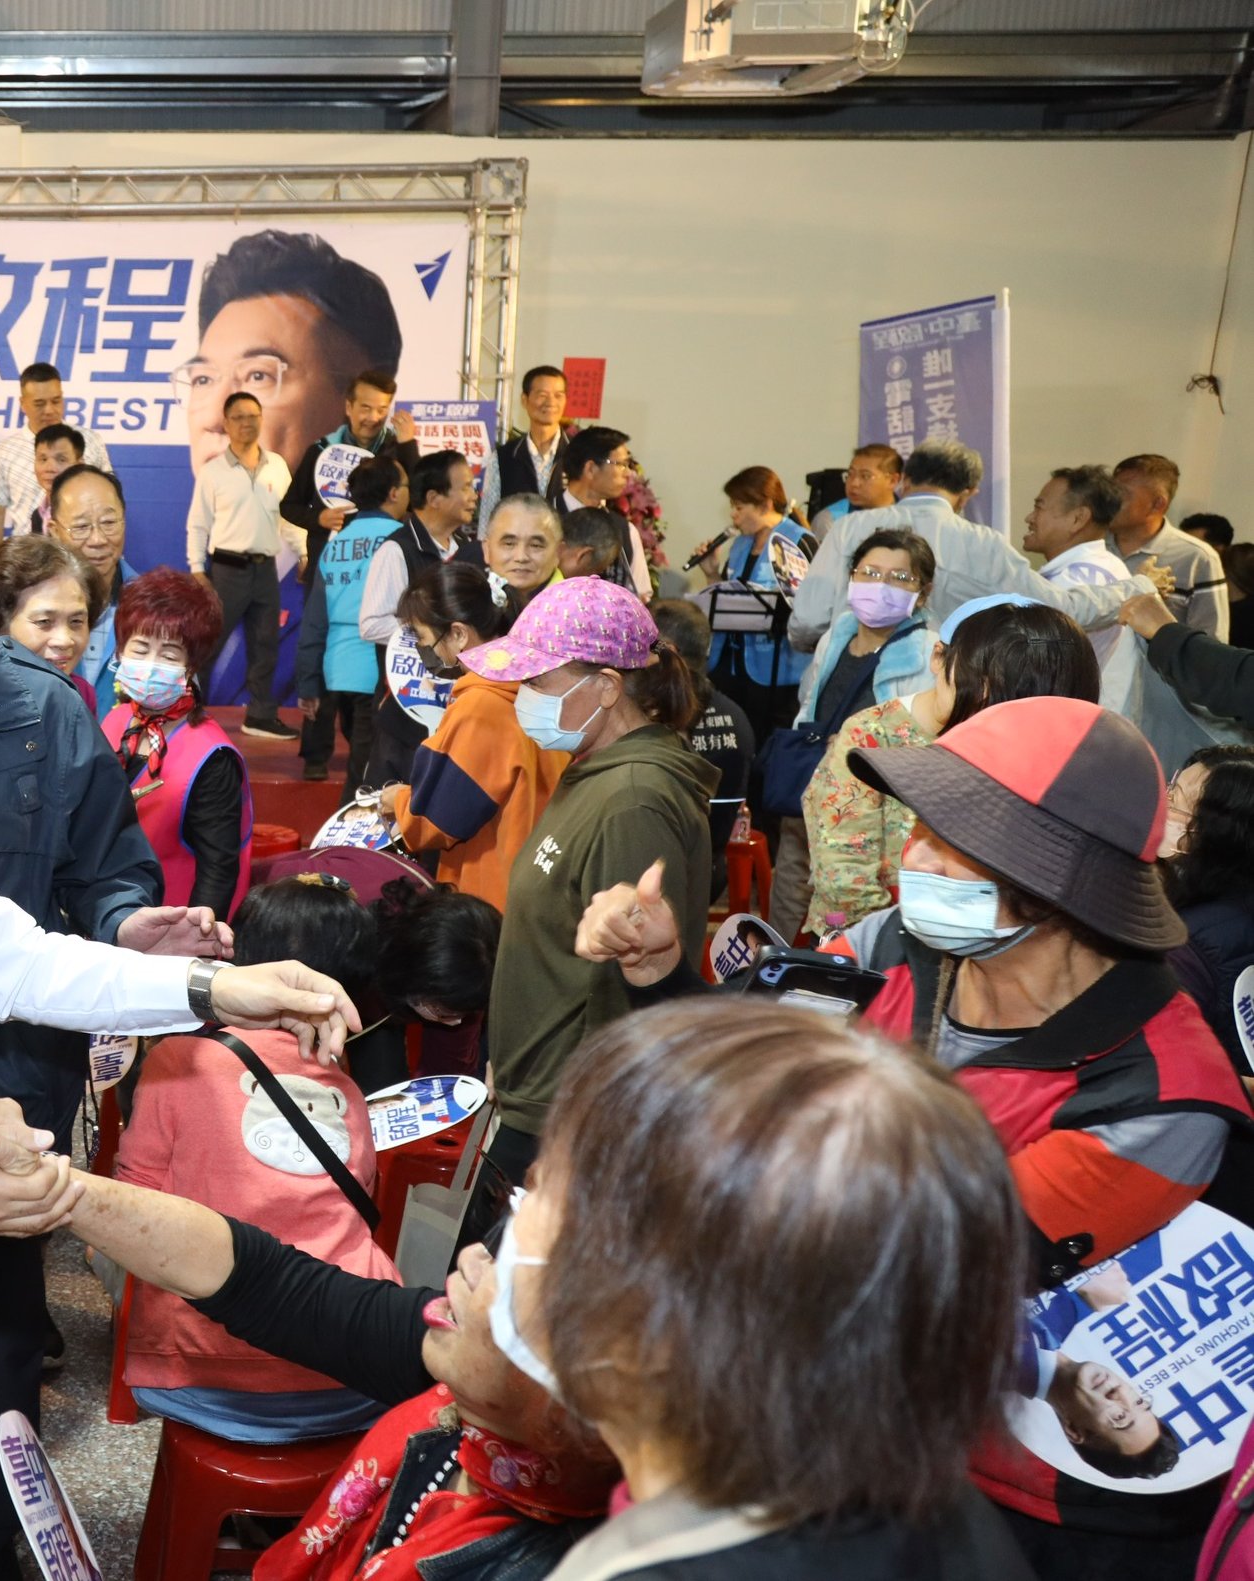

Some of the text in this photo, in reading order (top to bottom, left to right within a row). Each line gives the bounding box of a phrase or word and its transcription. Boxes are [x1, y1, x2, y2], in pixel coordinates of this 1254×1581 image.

[65, 397, 182, 430] BEST
[418, 440, 485, 458] 一支持
[93, 1050, 124, 1082] 臺
[387, 1104, 420, 1141] 啟程
[1089, 1231, 1254, 1378] 啟程
[1171, 1356, 1196, 1375] THE
[1139, 1370, 1171, 1395] BEST
